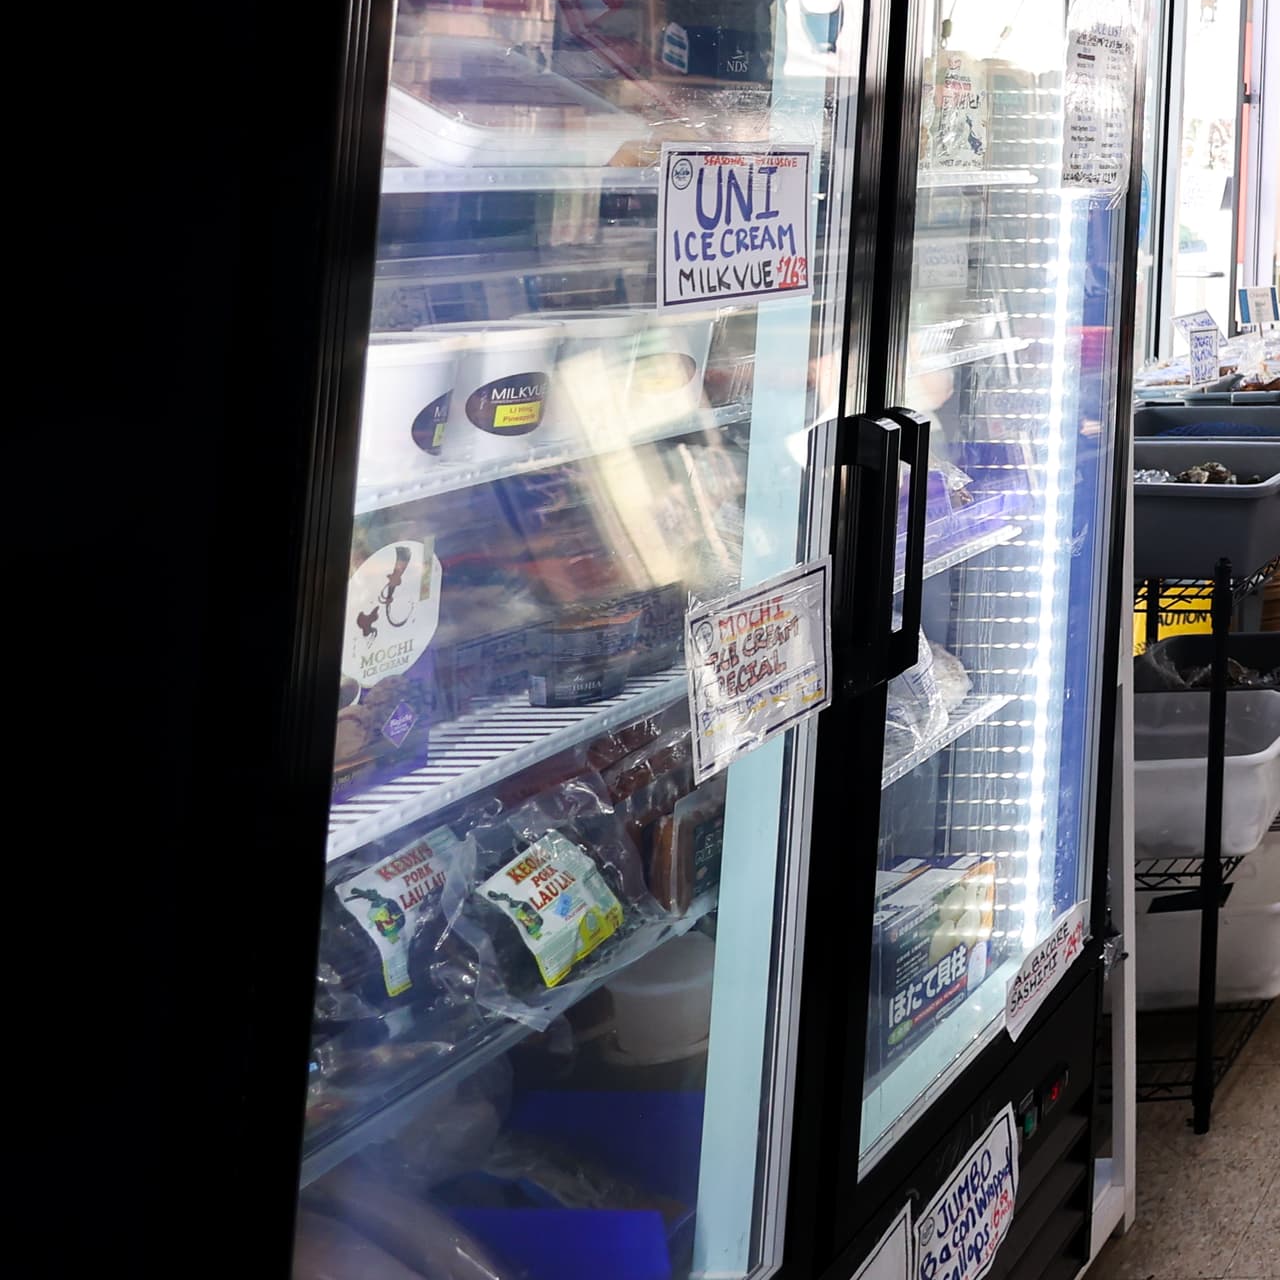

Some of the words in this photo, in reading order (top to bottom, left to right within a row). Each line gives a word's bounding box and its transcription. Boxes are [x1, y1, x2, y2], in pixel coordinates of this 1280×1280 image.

[725, 60, 749, 74] NDS
[695, 164, 779, 231] UNI
[673, 229, 717, 262] ICE
[720, 223, 797, 258] CREAM
[1158, 611, 1208, 627] AUTION
[359, 638, 414, 670] MOCHI
[716, 650, 788, 701] PECIAL
[1012, 921, 1070, 990] ALBACORE
[936, 1148, 992, 1238] JUMBO
